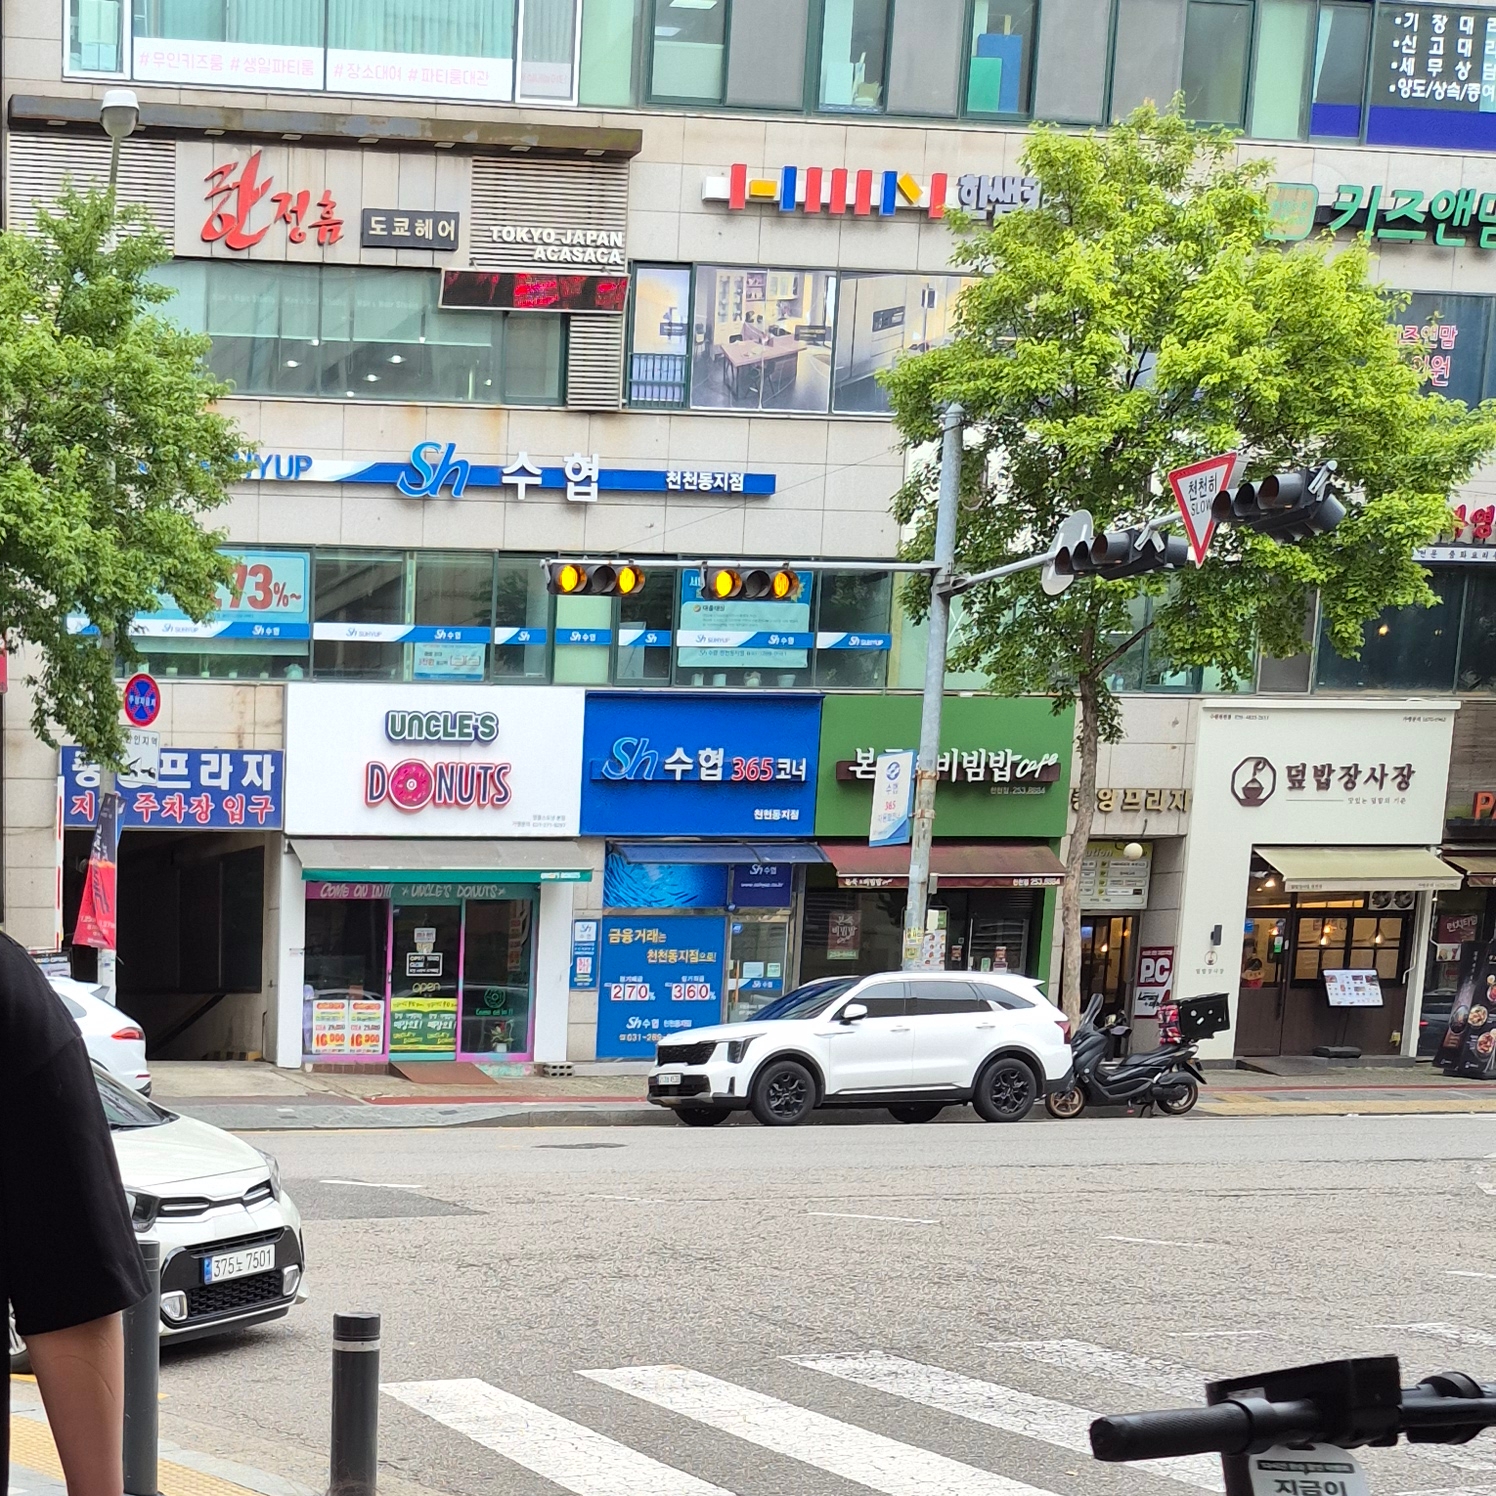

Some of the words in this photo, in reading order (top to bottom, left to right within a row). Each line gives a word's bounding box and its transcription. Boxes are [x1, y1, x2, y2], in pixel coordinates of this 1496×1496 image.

[368, 216, 455, 242] 도쿄헤어
[491, 225, 555, 245] TOKYO
[565, 230, 623, 248] JAPAN
[533, 247, 622, 264] ACASACA
[396, 440, 471, 499] Sh
[502, 451, 600, 502] 수협
[666, 470, 745, 492] 천천동지점
[1188, 472, 1218, 501] 천천히
[385, 710, 499, 743] UNCLE'S
[601, 737, 659, 780] Sh
[664, 747, 724, 781] 수협
[731, 757, 774, 782] 365
[775, 757, 807, 782] 코너
[1286, 762, 1416, 792] 덮밥장사장
[133, 791, 215, 824] 주차장
[223, 793, 275, 825] 입구
[884, 800, 896, 811] 365
[411, 883, 452, 898] UNCLE'S
[456, 884, 498, 899] DONUTS
[1139, 957, 1170, 983] PC
[412, 981, 441, 994] open
[213, 1256, 243, 1278] 375노
[246, 1248, 271, 1271] 7501
